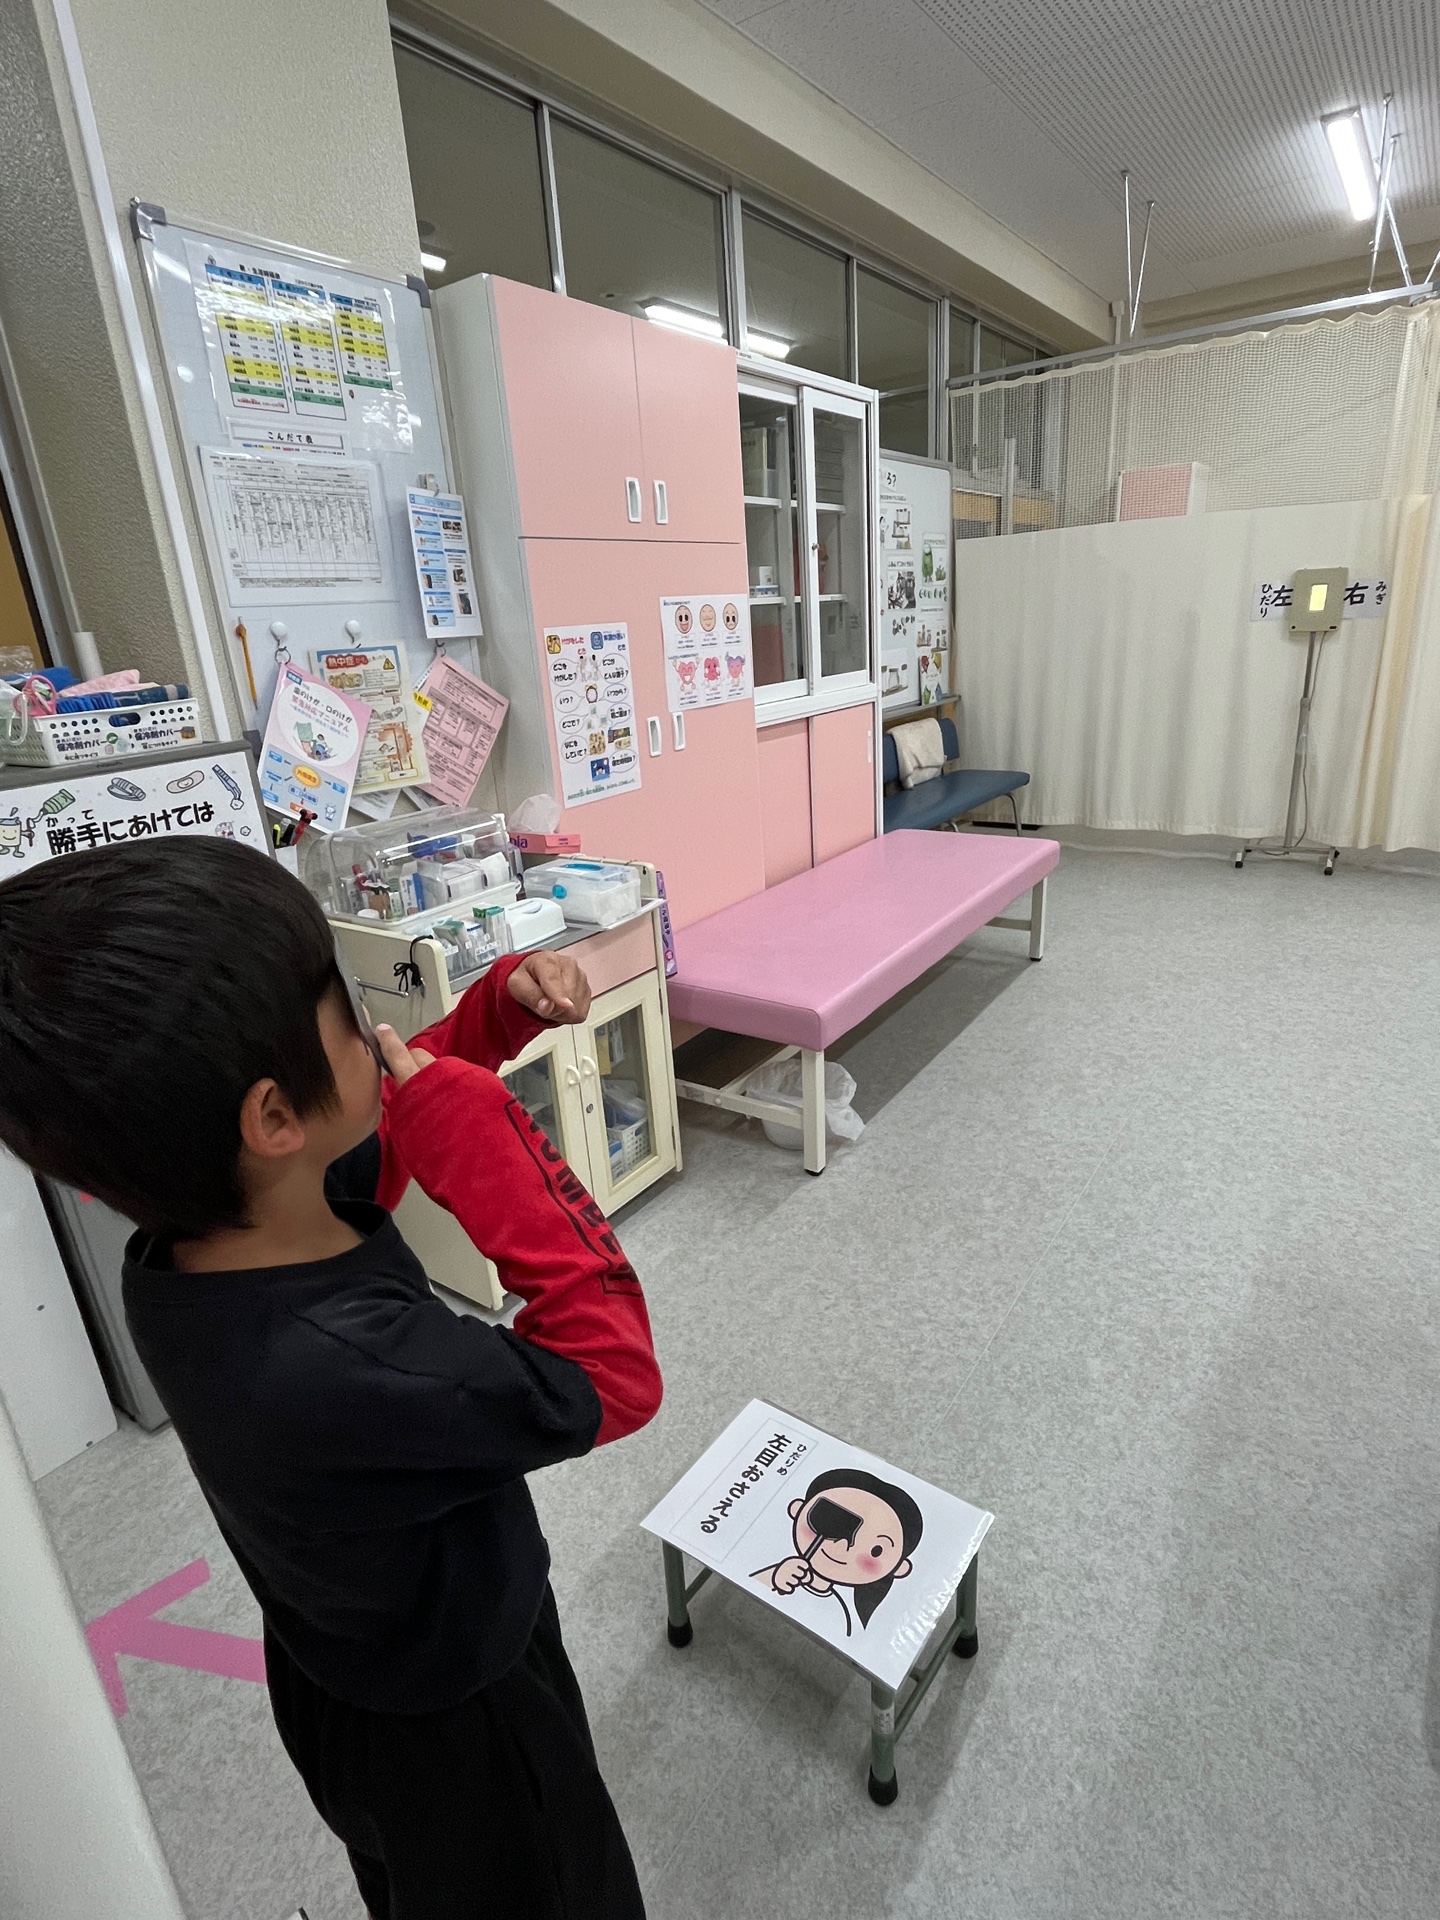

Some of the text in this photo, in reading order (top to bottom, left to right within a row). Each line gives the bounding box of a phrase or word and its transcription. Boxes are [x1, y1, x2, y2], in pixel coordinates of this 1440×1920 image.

[267, 431, 313, 444] こんだて表
[1260, 583, 1273, 618] ひだり
[1270, 585, 1294, 607] 左
[1343, 582, 1369, 605] 右
[1375, 581, 1387, 605] みぎ
[57, 740, 107, 752] 保冷剤カバー
[134, 729, 182, 741] 保冷剤カバー
[46, 802, 215, 856] 勝手にあけては
[776, 1443, 807, 1476] ひだりめ
[700, 1432, 792, 1534] 左目おさえる
